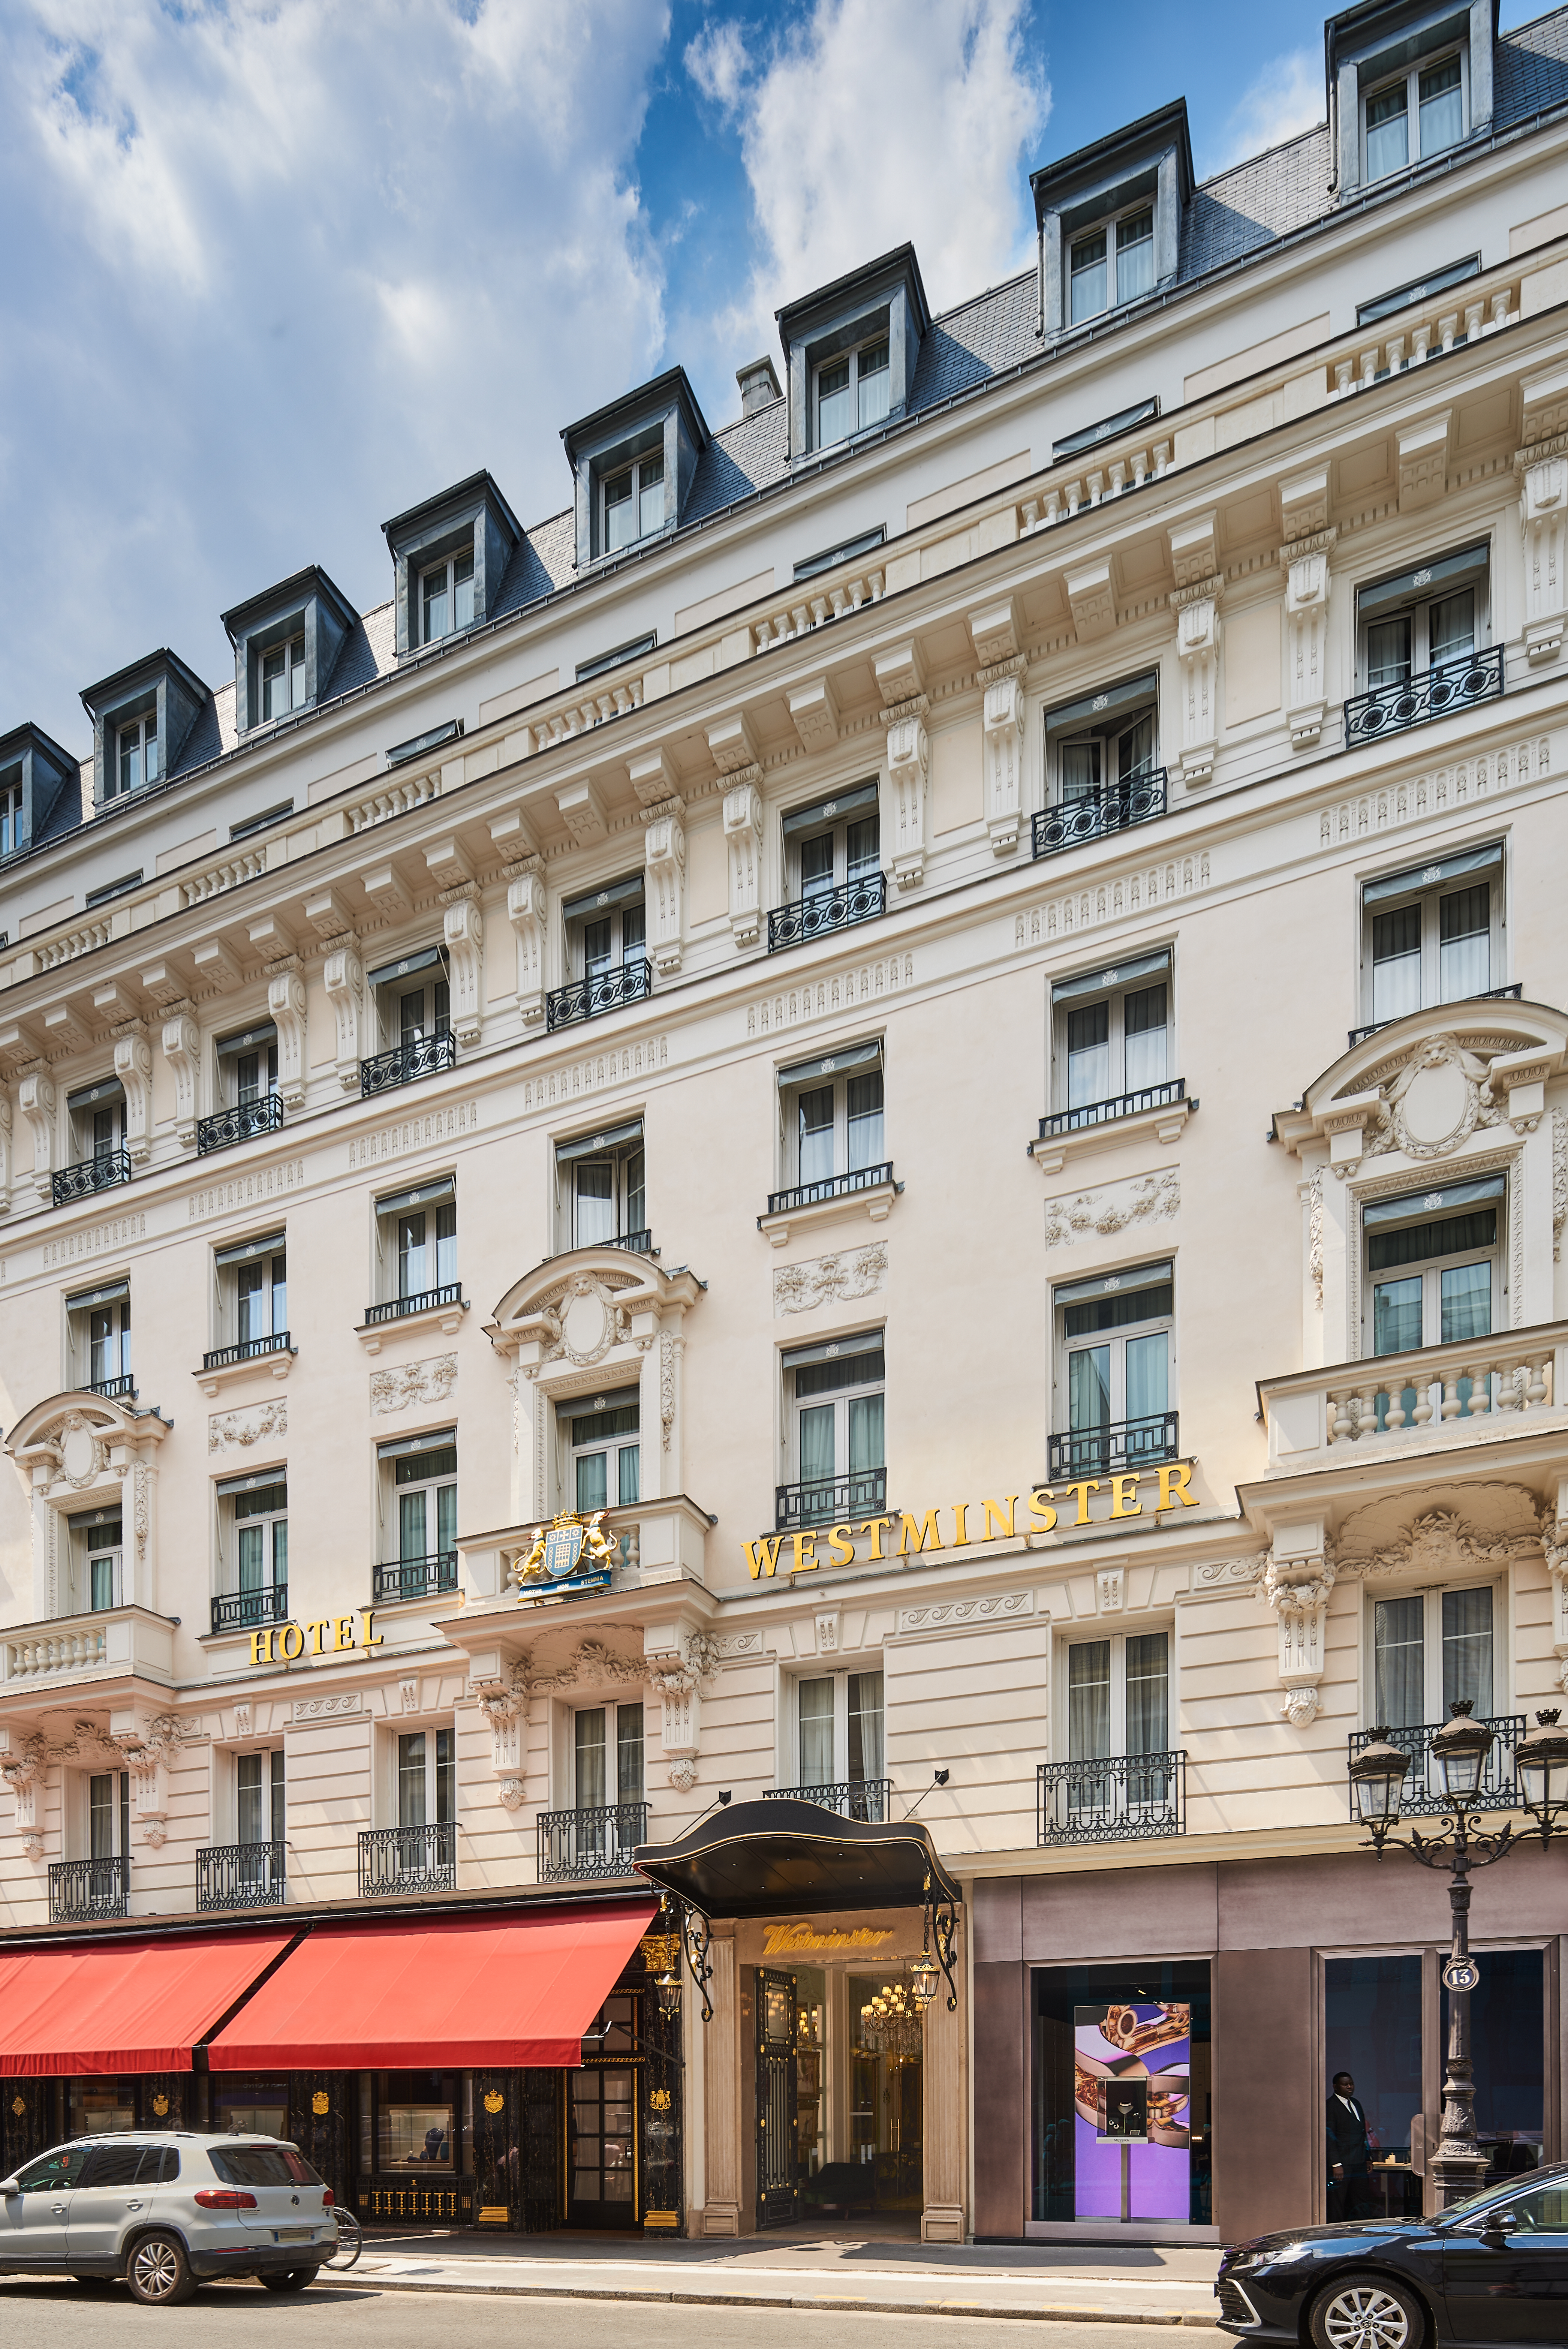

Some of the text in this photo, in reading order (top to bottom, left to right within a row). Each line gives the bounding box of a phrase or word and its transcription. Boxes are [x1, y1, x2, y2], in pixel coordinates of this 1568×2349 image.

[740, 1464, 1201, 1580] WESTMINSTER
[581, 1576, 604, 1585] STEMMA
[249, 1612, 384, 1666] HOTEL
[762, 1922, 893, 1955] Westminster
[1451, 1968, 1470, 1985] 13
